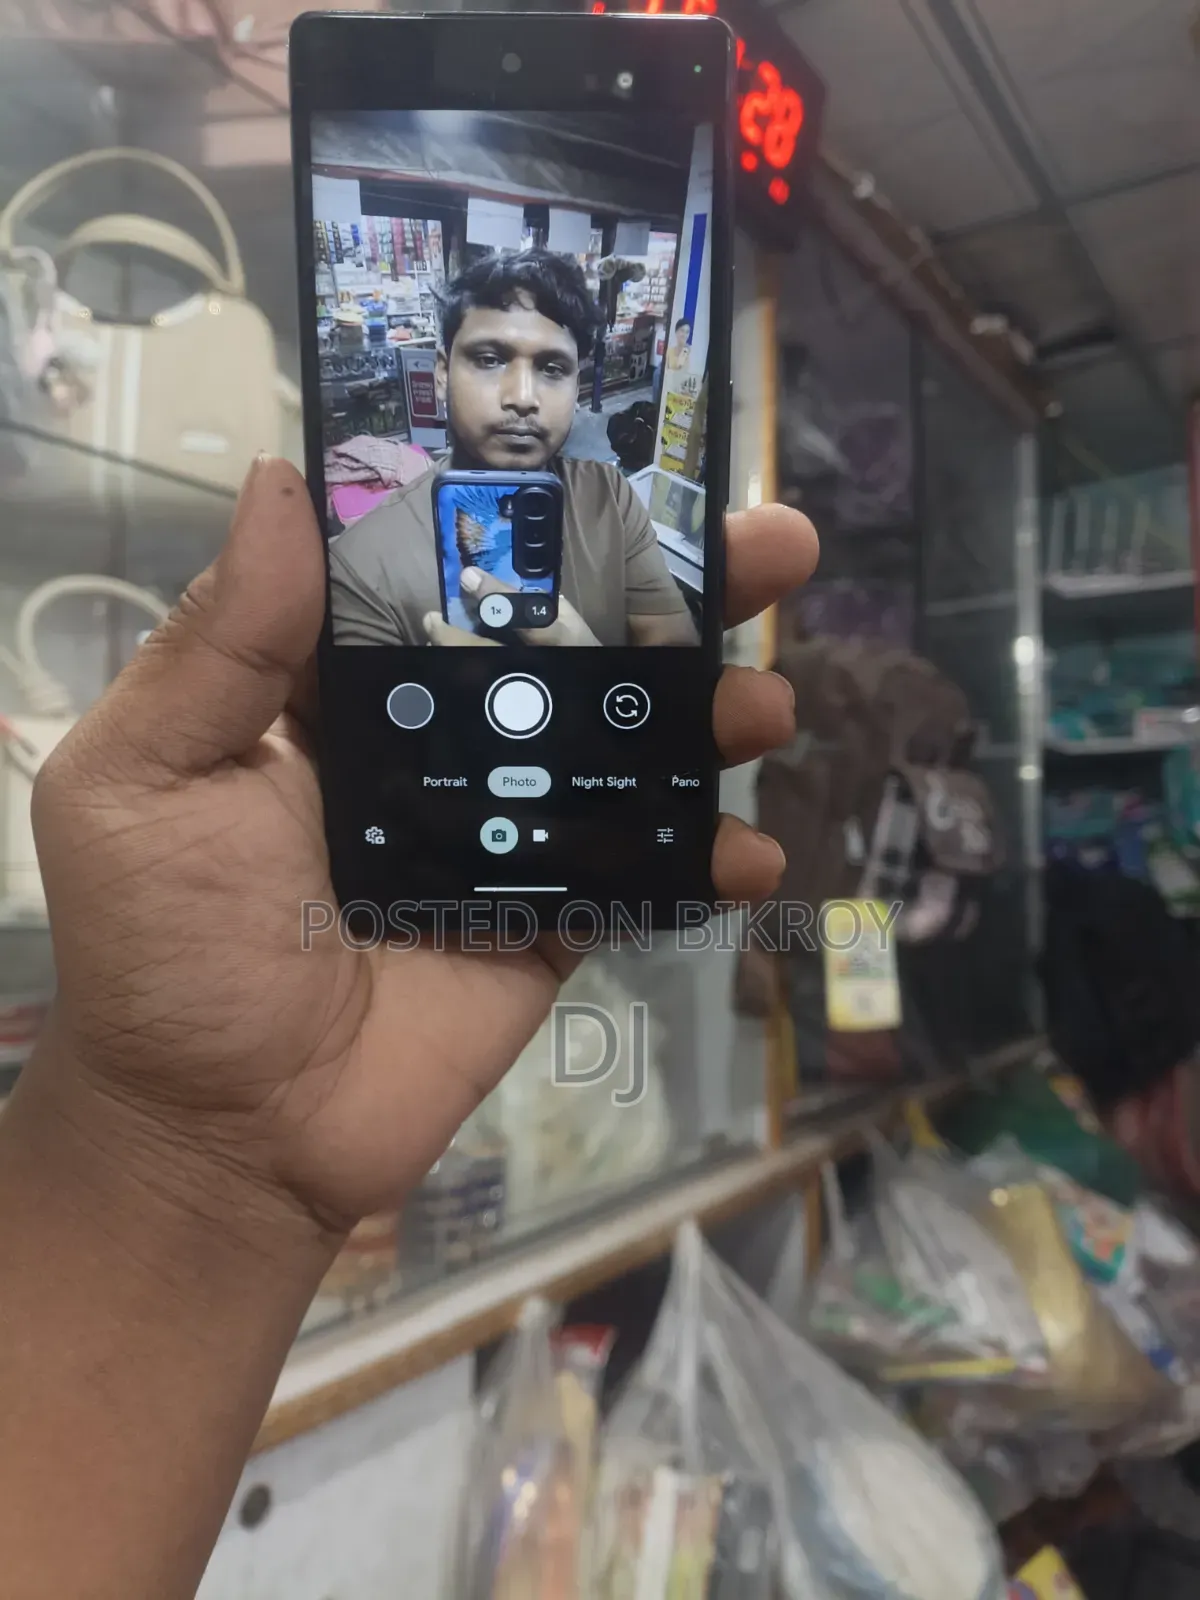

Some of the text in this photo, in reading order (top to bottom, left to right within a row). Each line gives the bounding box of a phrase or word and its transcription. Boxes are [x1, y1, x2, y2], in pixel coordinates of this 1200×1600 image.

[532, 606, 547, 616] 1.4
[423, 776, 468, 787] Portrait
[502, 776, 537, 787] Photo
[571, 776, 637, 789] Night Sight
[671, 776, 700, 787] Pano
